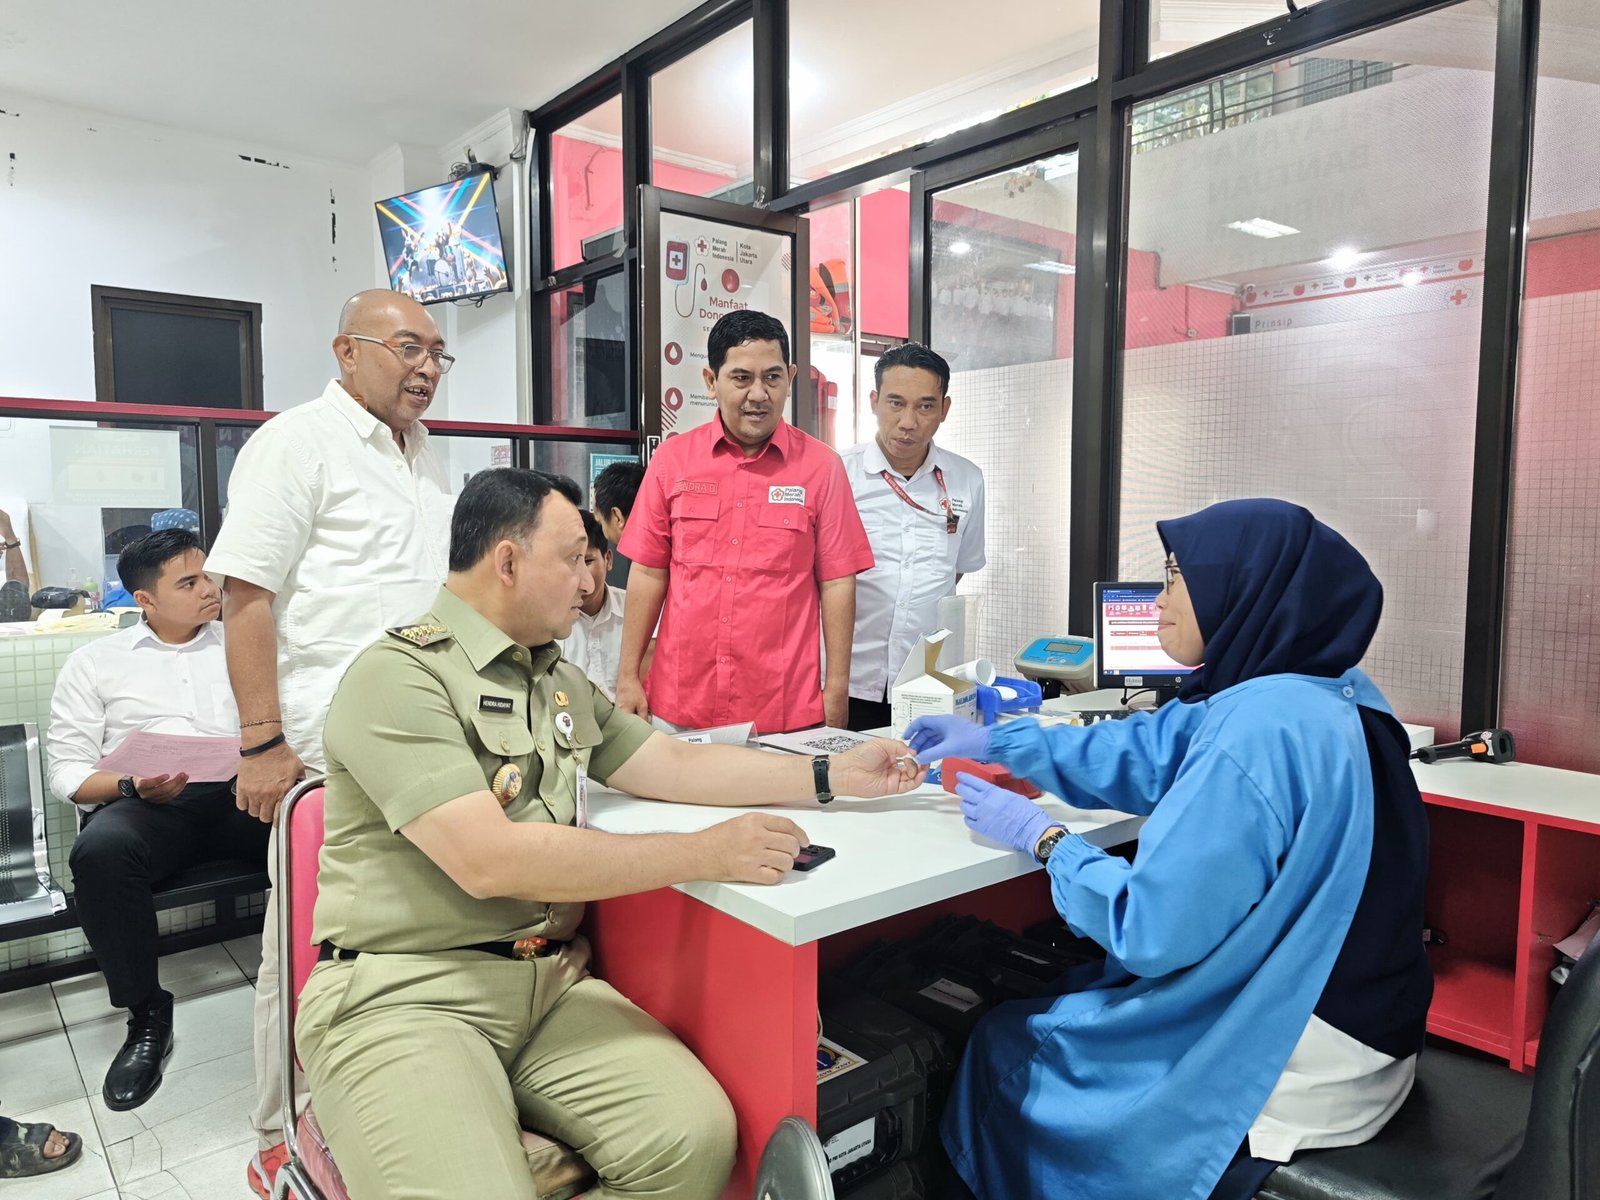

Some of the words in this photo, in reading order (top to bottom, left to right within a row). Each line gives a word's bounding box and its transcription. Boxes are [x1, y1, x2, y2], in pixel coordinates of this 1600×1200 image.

[712, 237, 728, 247] Palang
[740, 242, 752, 250] Kota
[712, 252, 734, 262] Indonesia
[740, 251, 758, 259] Jakarta
[740, 257, 753, 265] Utara
[709, 296, 748, 310] Manfaat
[1255, 318, 1293, 330] Prinsip
[785, 487, 803, 495] Palang
